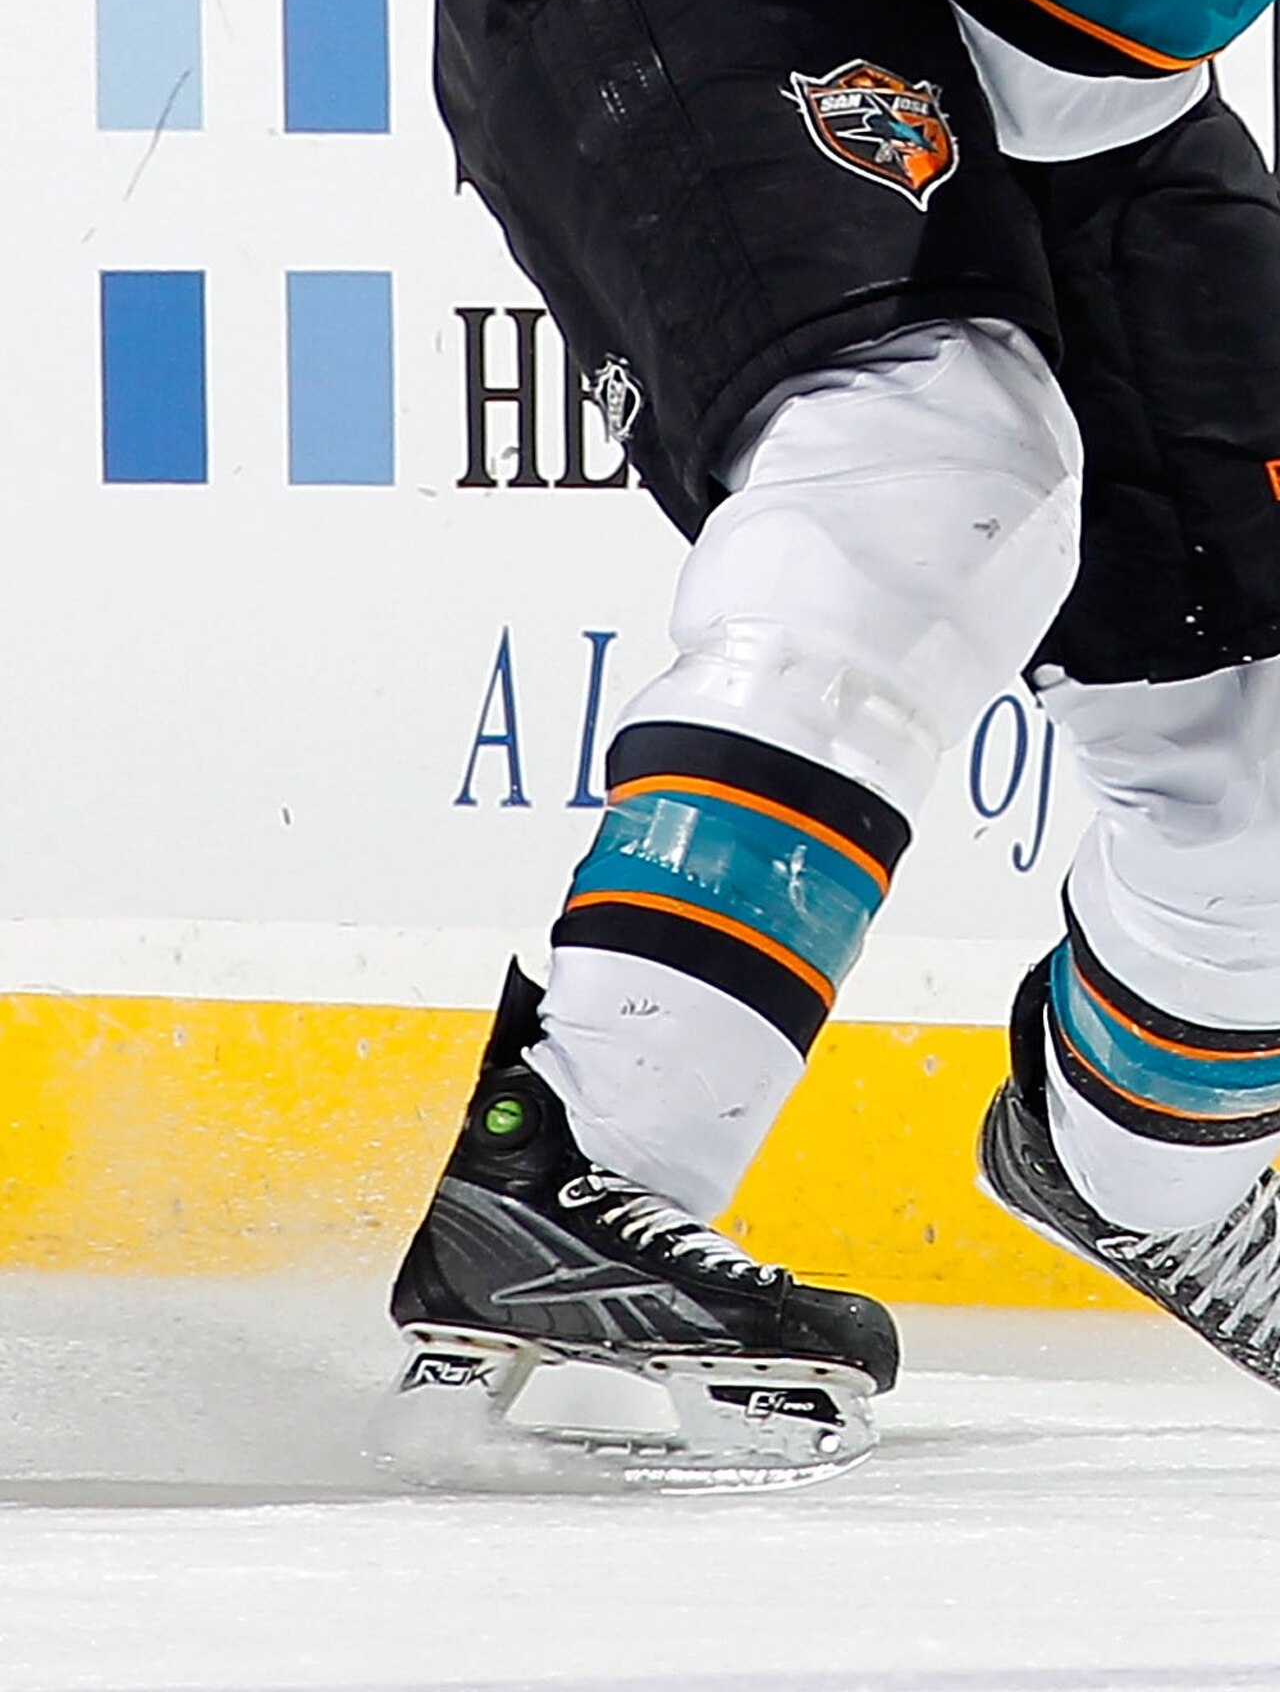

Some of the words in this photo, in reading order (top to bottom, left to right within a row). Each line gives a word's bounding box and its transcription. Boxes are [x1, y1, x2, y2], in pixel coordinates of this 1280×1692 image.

[820, 94, 862, 112] SAN
[453, 625, 532, 807] A
[566, 630, 617, 807] L
